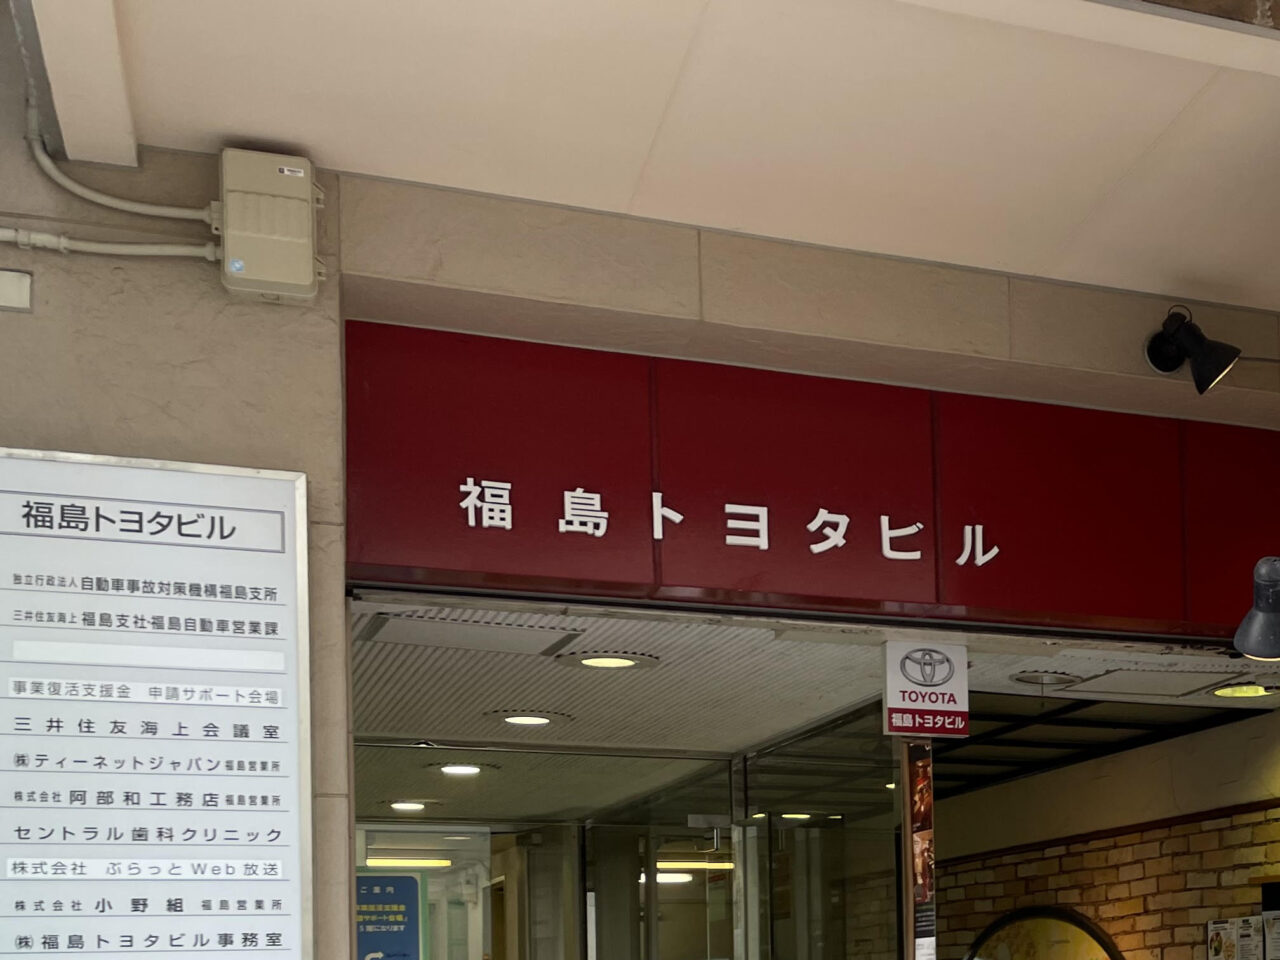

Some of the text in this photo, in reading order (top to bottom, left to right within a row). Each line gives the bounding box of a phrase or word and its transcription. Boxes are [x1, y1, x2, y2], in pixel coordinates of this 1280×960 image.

[22, 501, 236, 541] 福島トヨタビル
[459, 477, 1000, 567] 福島トヨタビル
[12, 680, 279, 705] 事業復活支援金 申請サポート会場
[899, 690, 957, 705] TOYOTA
[14, 717, 280, 740] 三井住友海上会議室
[891, 712, 965, 729] 福島トヨタビル
[13, 826, 282, 843] セントラル歯科クリニック
[11, 861, 87, 876] 株式会社
